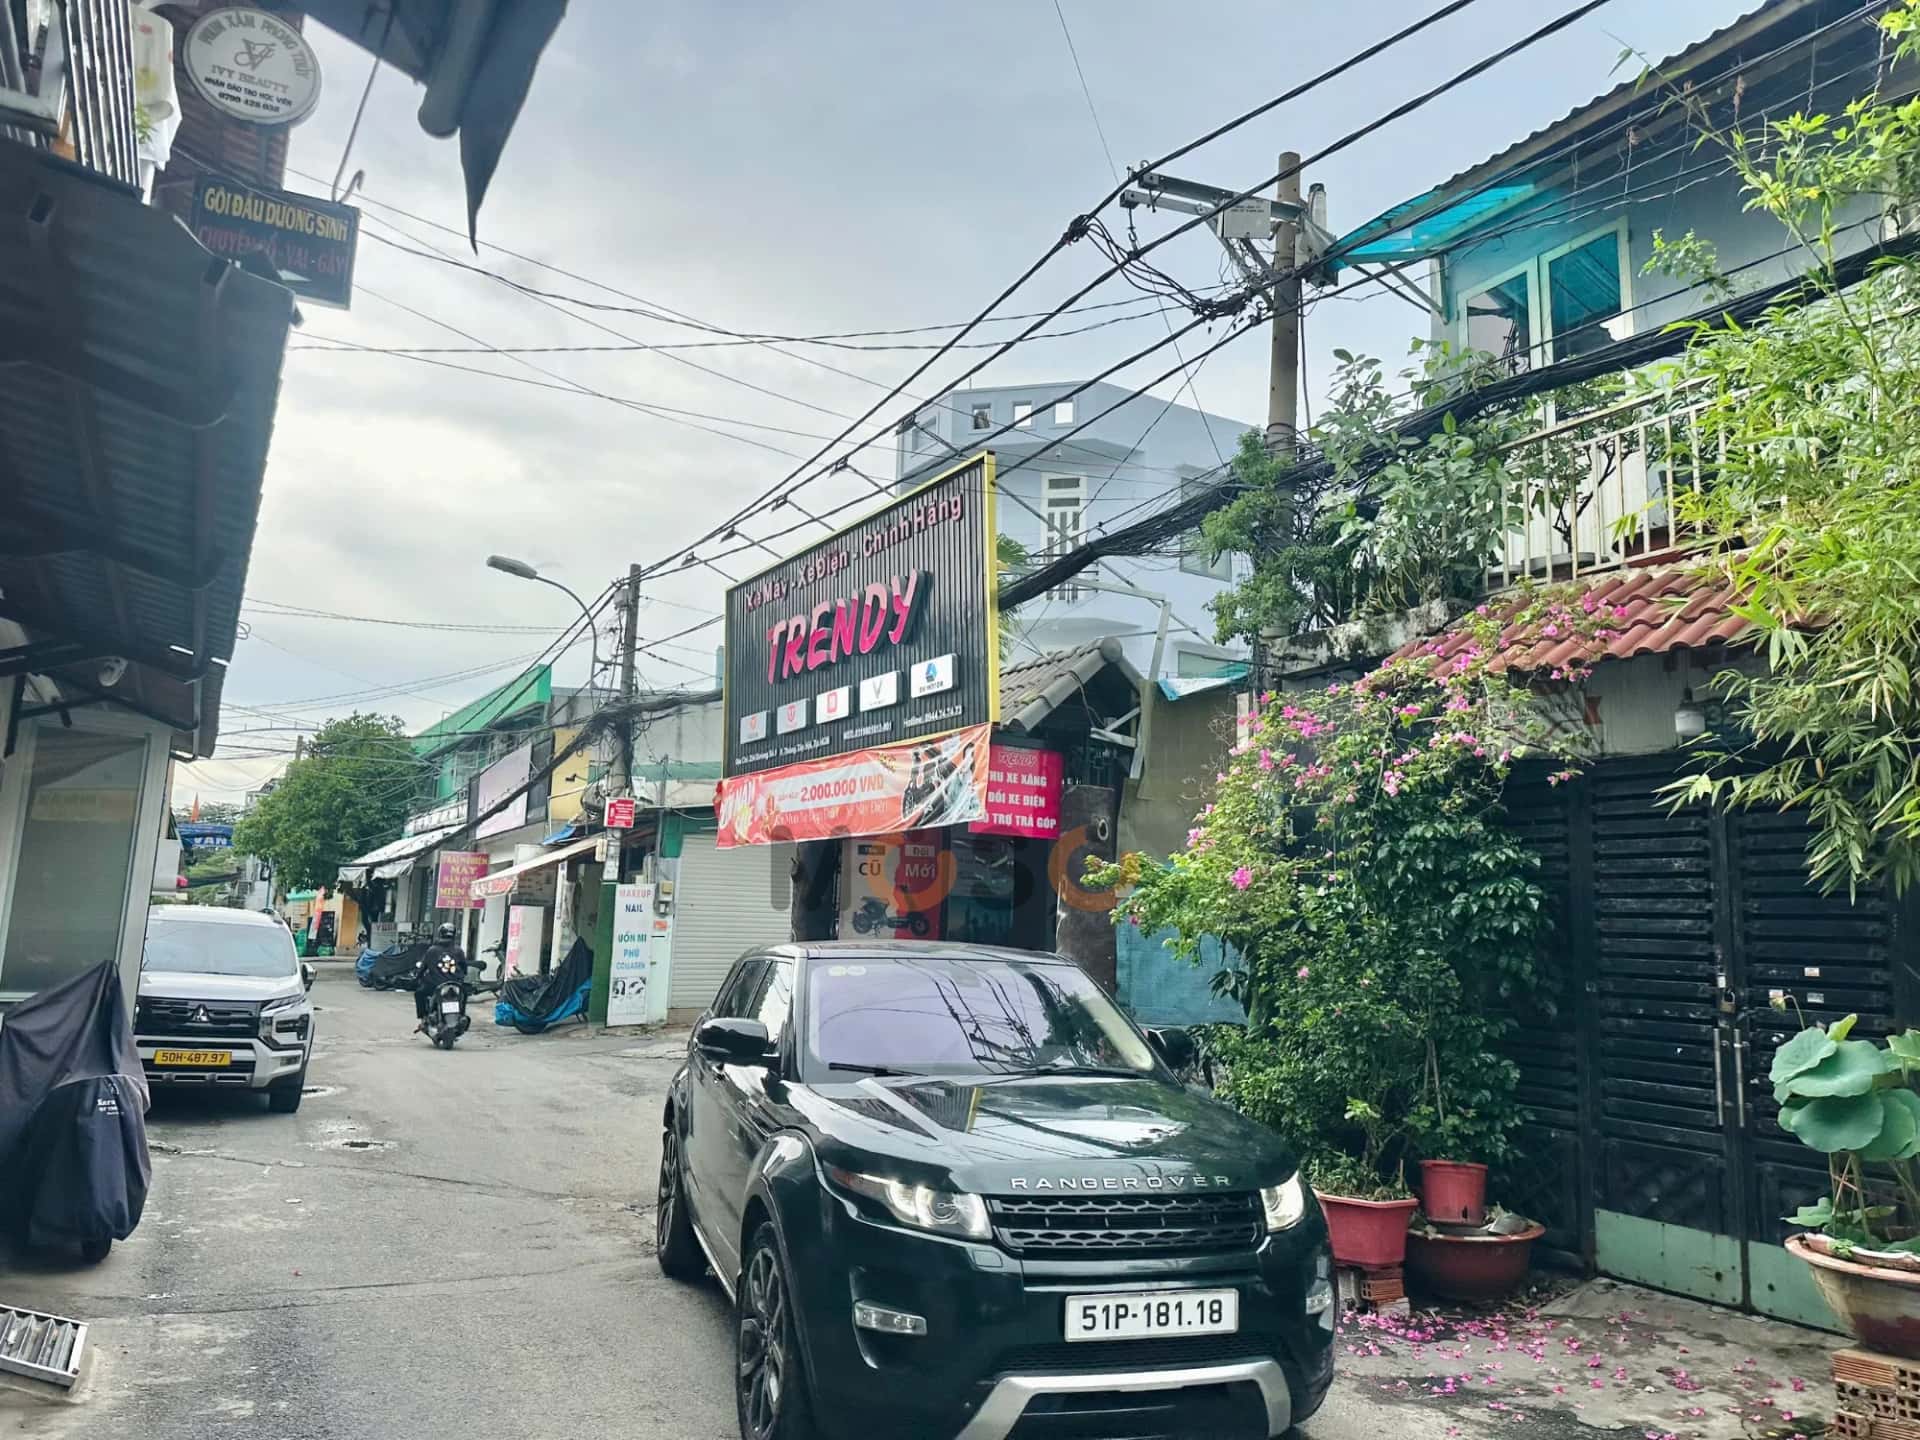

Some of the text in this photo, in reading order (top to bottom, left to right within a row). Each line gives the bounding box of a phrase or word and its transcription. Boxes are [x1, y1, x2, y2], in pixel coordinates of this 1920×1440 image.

[239, 72, 289, 94] BEAUTY
[316, 216, 349, 241] SINH
[863, 521, 913, 558] Chính
[766, 568, 920, 686] TRENDY
[989, 770, 1004, 783] HU
[1006, 772, 1020, 784] XE
[800, 779, 857, 803] 2.000.000
[1008, 793, 1021, 806] XE
[904, 862, 937, 879] Mới
[619, 889, 652, 898] MAKEUP
[625, 903, 644, 913] NAIL
[1082, 1298, 1223, 1332] 51P-181.18
